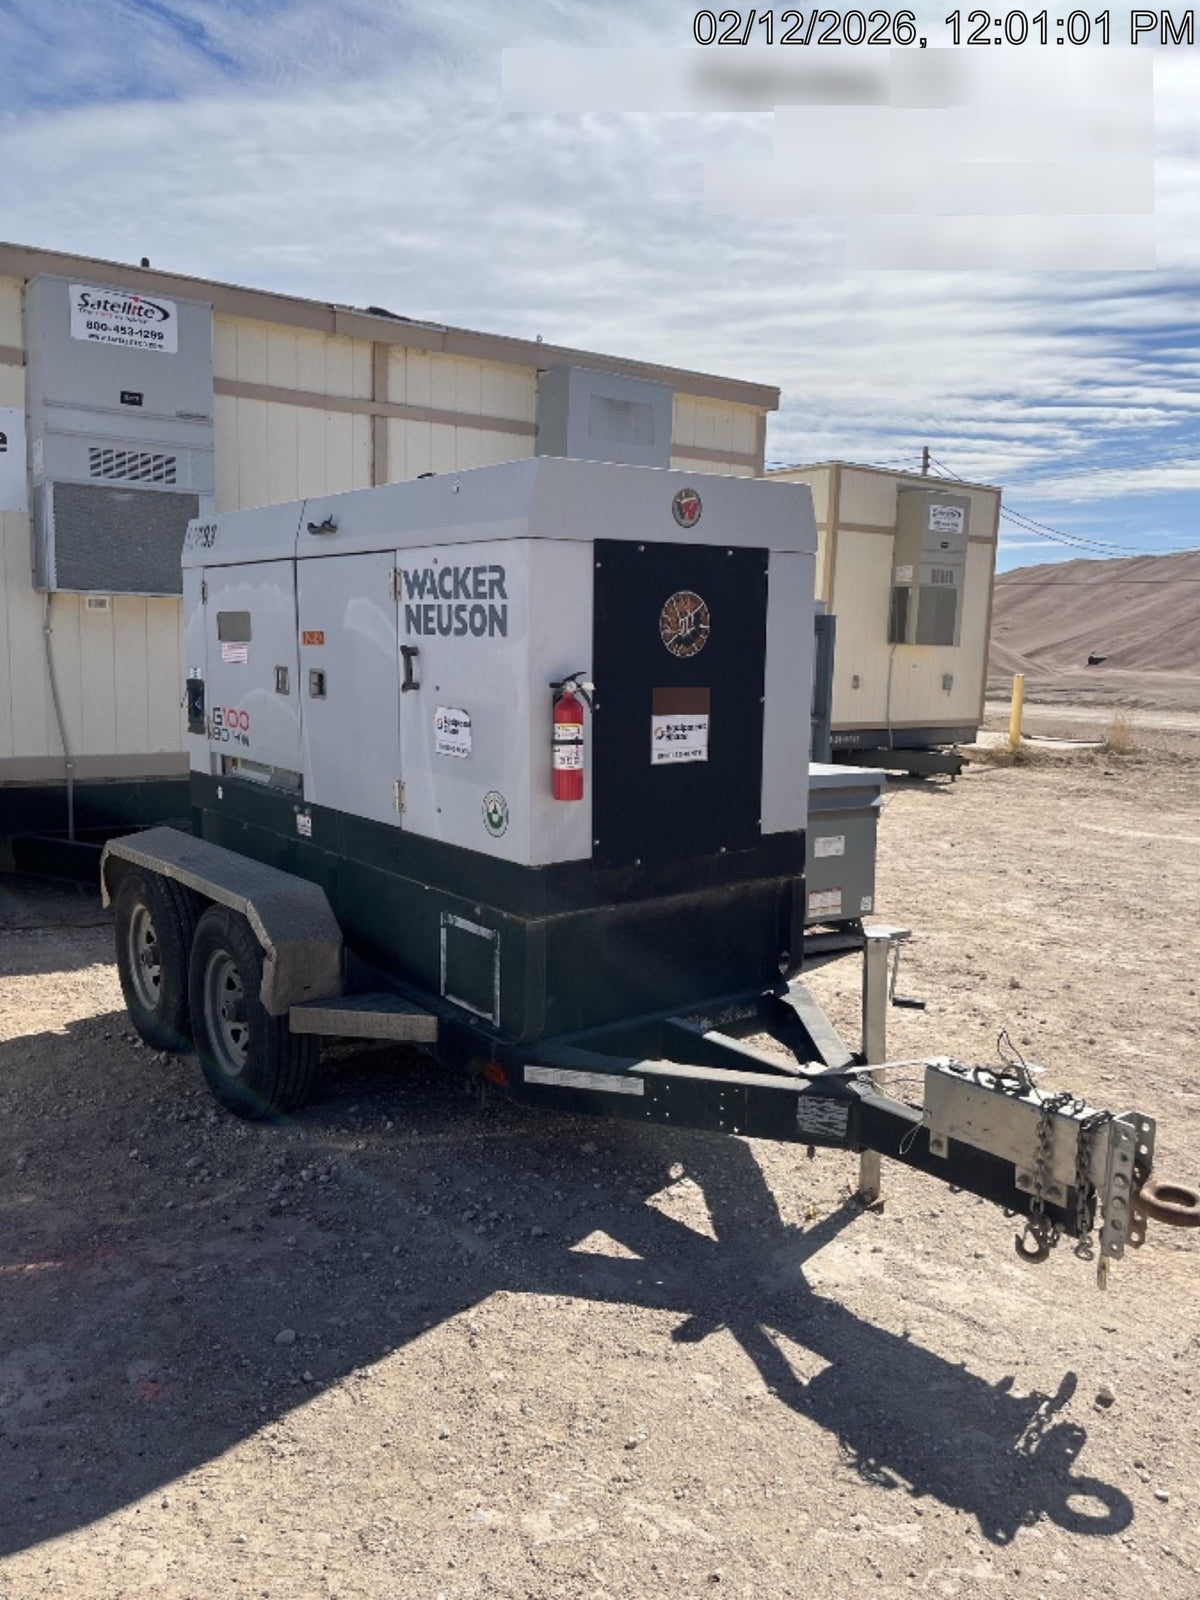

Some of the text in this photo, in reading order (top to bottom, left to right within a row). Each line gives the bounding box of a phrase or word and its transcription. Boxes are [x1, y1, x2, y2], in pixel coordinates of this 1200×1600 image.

[77, 292, 156, 319] Satellite
[403, 565, 508, 600] WACKER
[405, 604, 508, 637] NEUSON
[213, 707, 249, 731] G100
